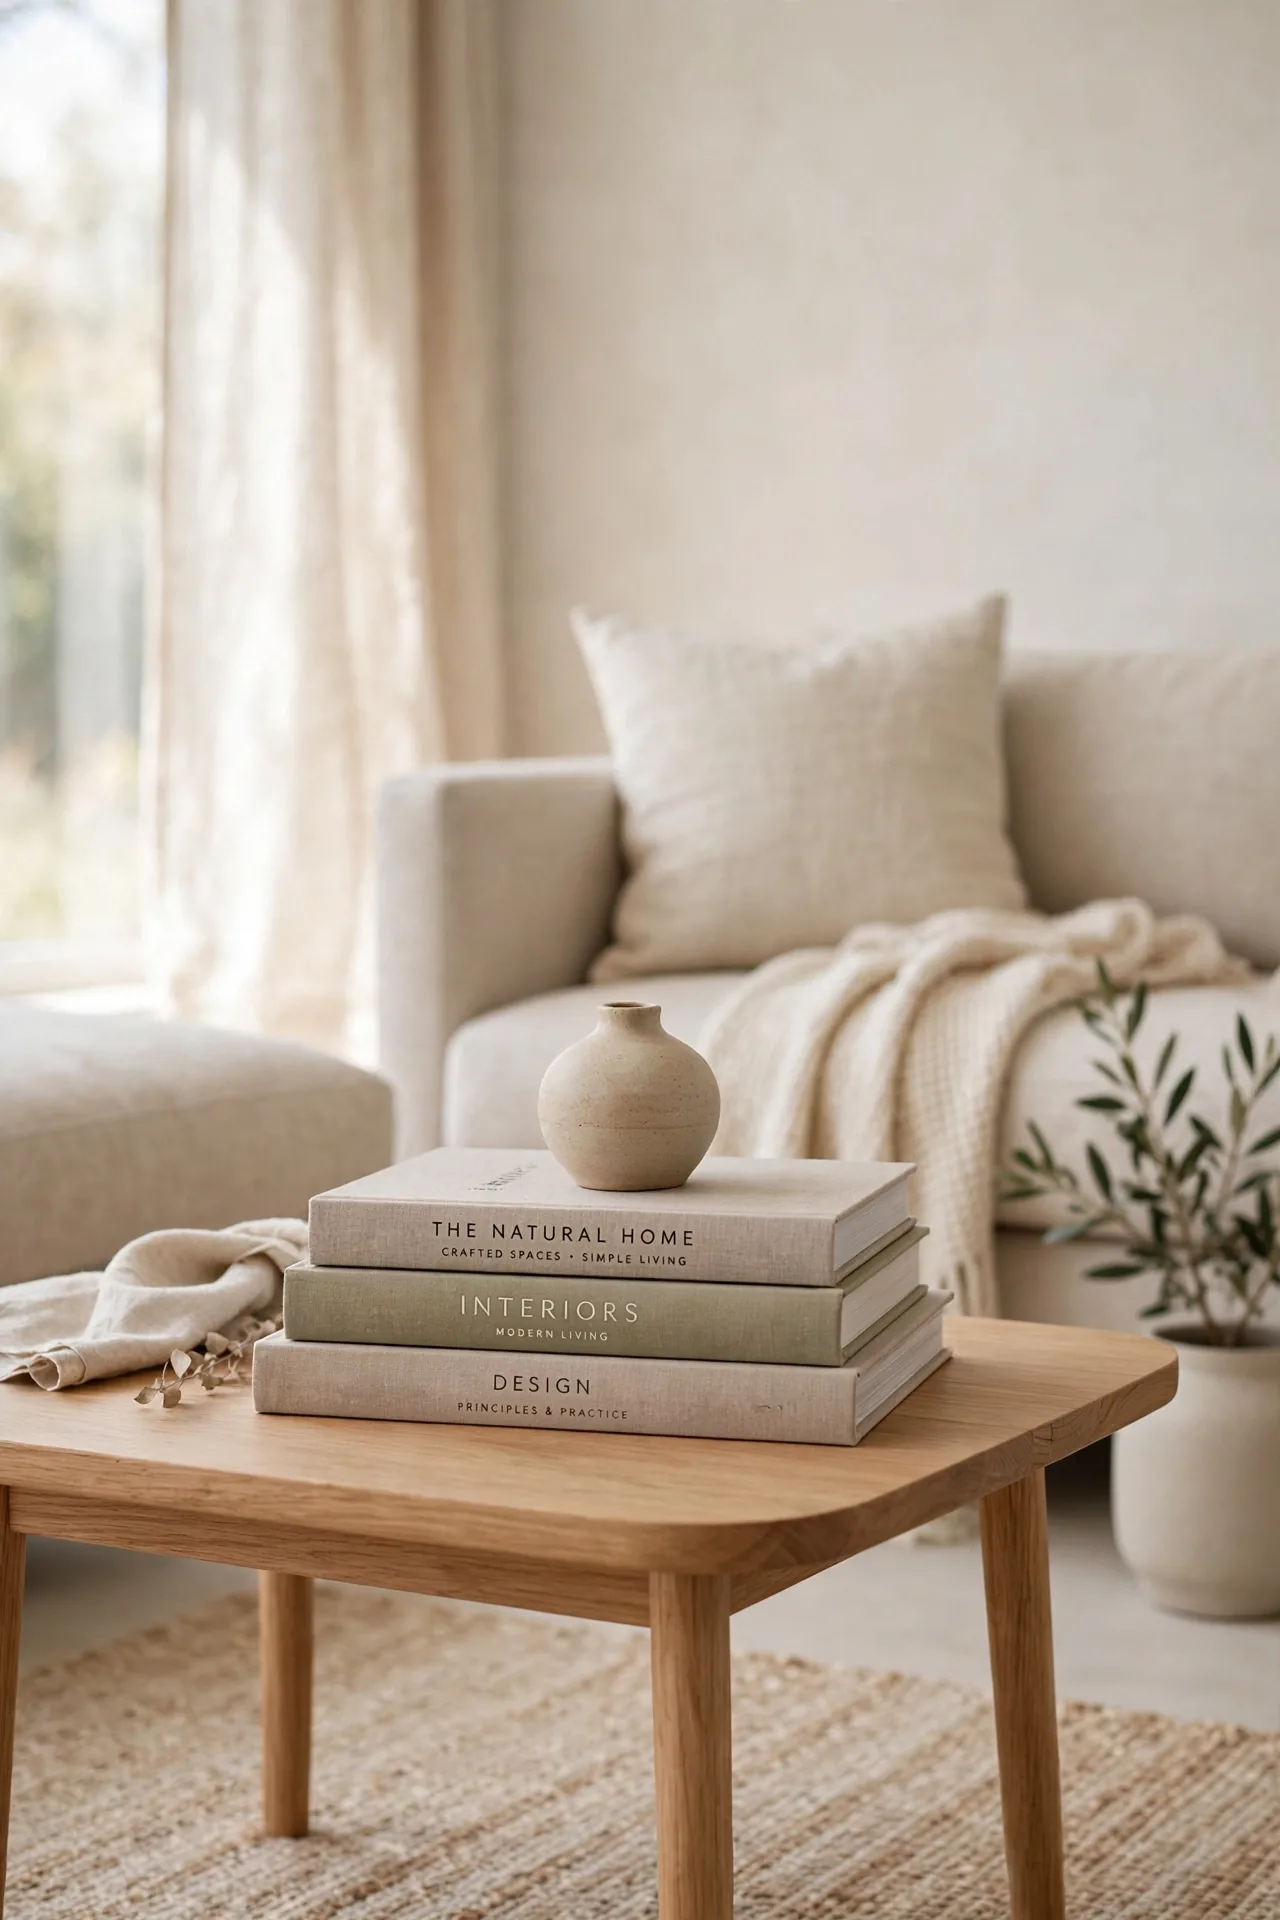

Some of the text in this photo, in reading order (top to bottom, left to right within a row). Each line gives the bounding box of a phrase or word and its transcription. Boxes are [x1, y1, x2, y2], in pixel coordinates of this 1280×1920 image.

[432, 1221, 694, 1246] THE NATURAL HOME
[441, 1247, 503, 1259] CRAFTED
[510, 1250, 561, 1261] SPACES
[582, 1252, 632, 1264] SIMPLE
[639, 1255, 687, 1266] LIVING
[460, 1295, 639, 1323] INTERIORS
[496, 1328, 608, 1341] MODERN LIVING
[493, 1374, 591, 1395] DESIGN
[457, 1402, 628, 1419] PRINCIPLES & PRACTICE
